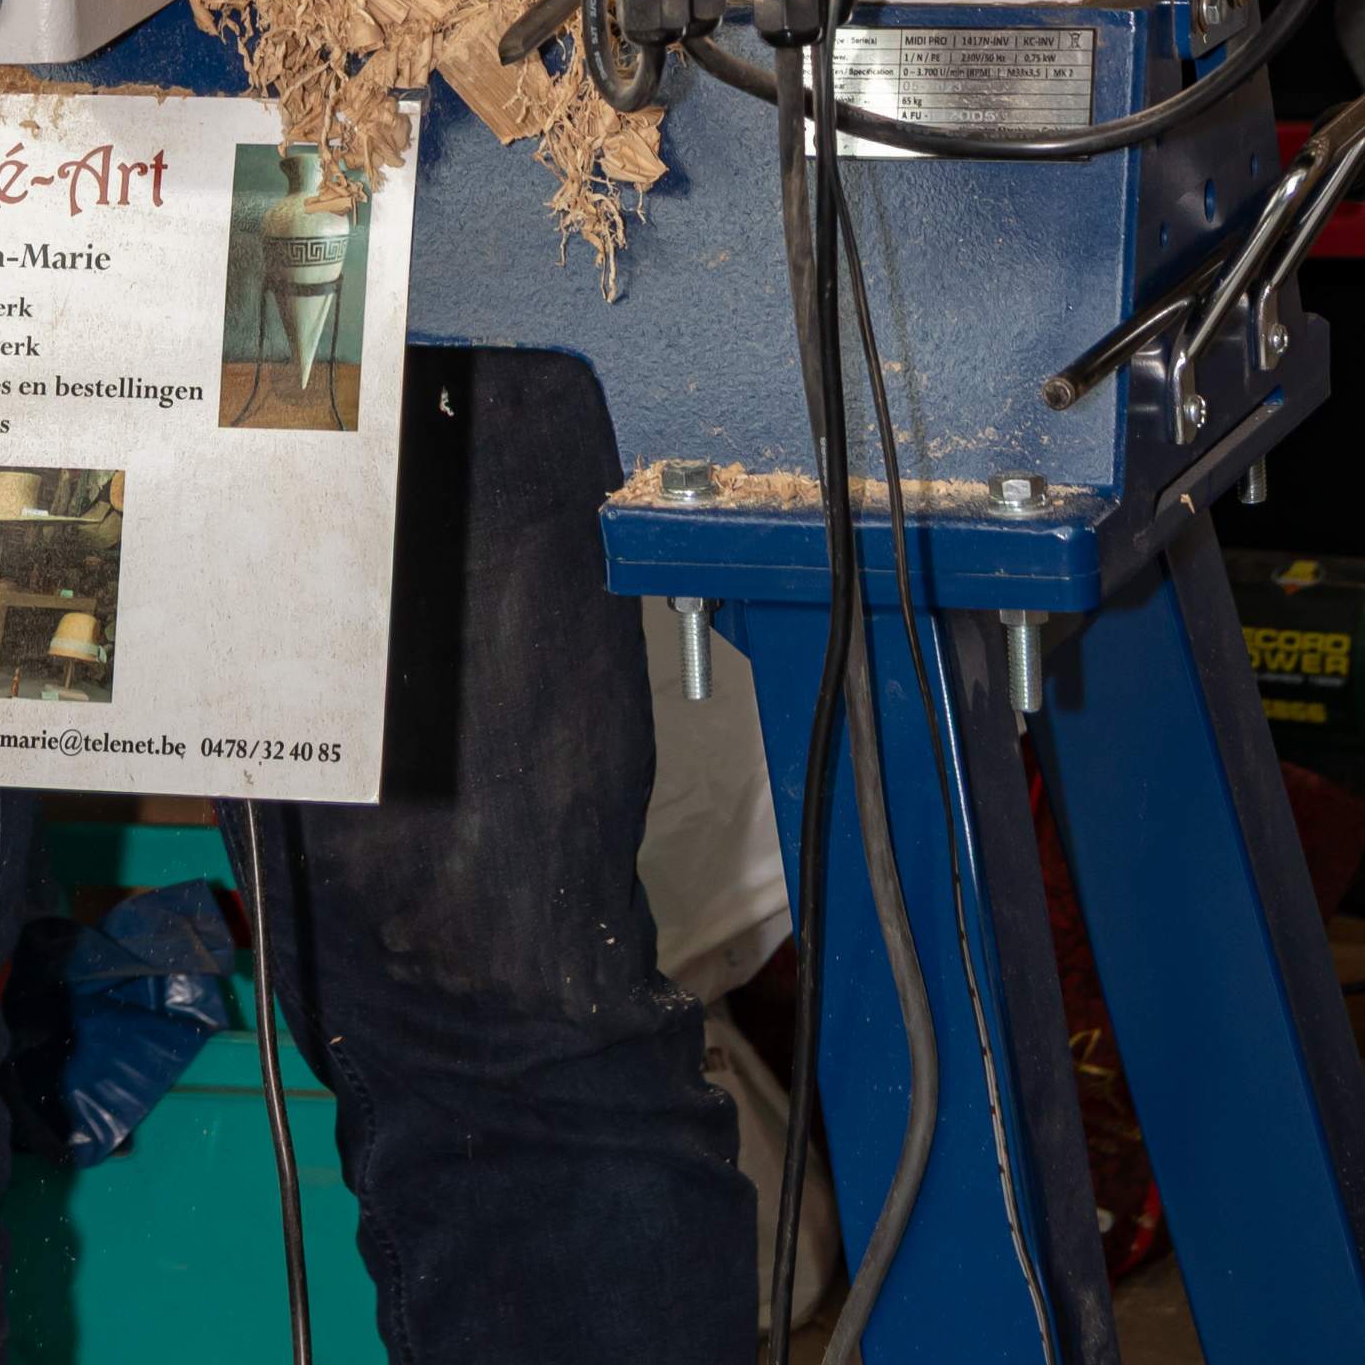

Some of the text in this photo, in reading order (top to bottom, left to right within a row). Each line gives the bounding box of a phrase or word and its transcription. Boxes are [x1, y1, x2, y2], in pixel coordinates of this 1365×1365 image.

[905, 36, 926, 45] MIDI
[928, 36, 947, 45] PRO
[1023, 37, 1054, 46] KC-INV
[848, 68, 894, 76] Specification
[902, 96, 922, 107] 65 kg
[19, 381, 47, 397] en
[55, 375, 205, 409] bestellingen
[1242, 626, 1353, 655] ECORD
[1248, 648, 1350, 677] OWER
[289, 743, 314, 762] 40
[317, 744, 342, 763] 85
